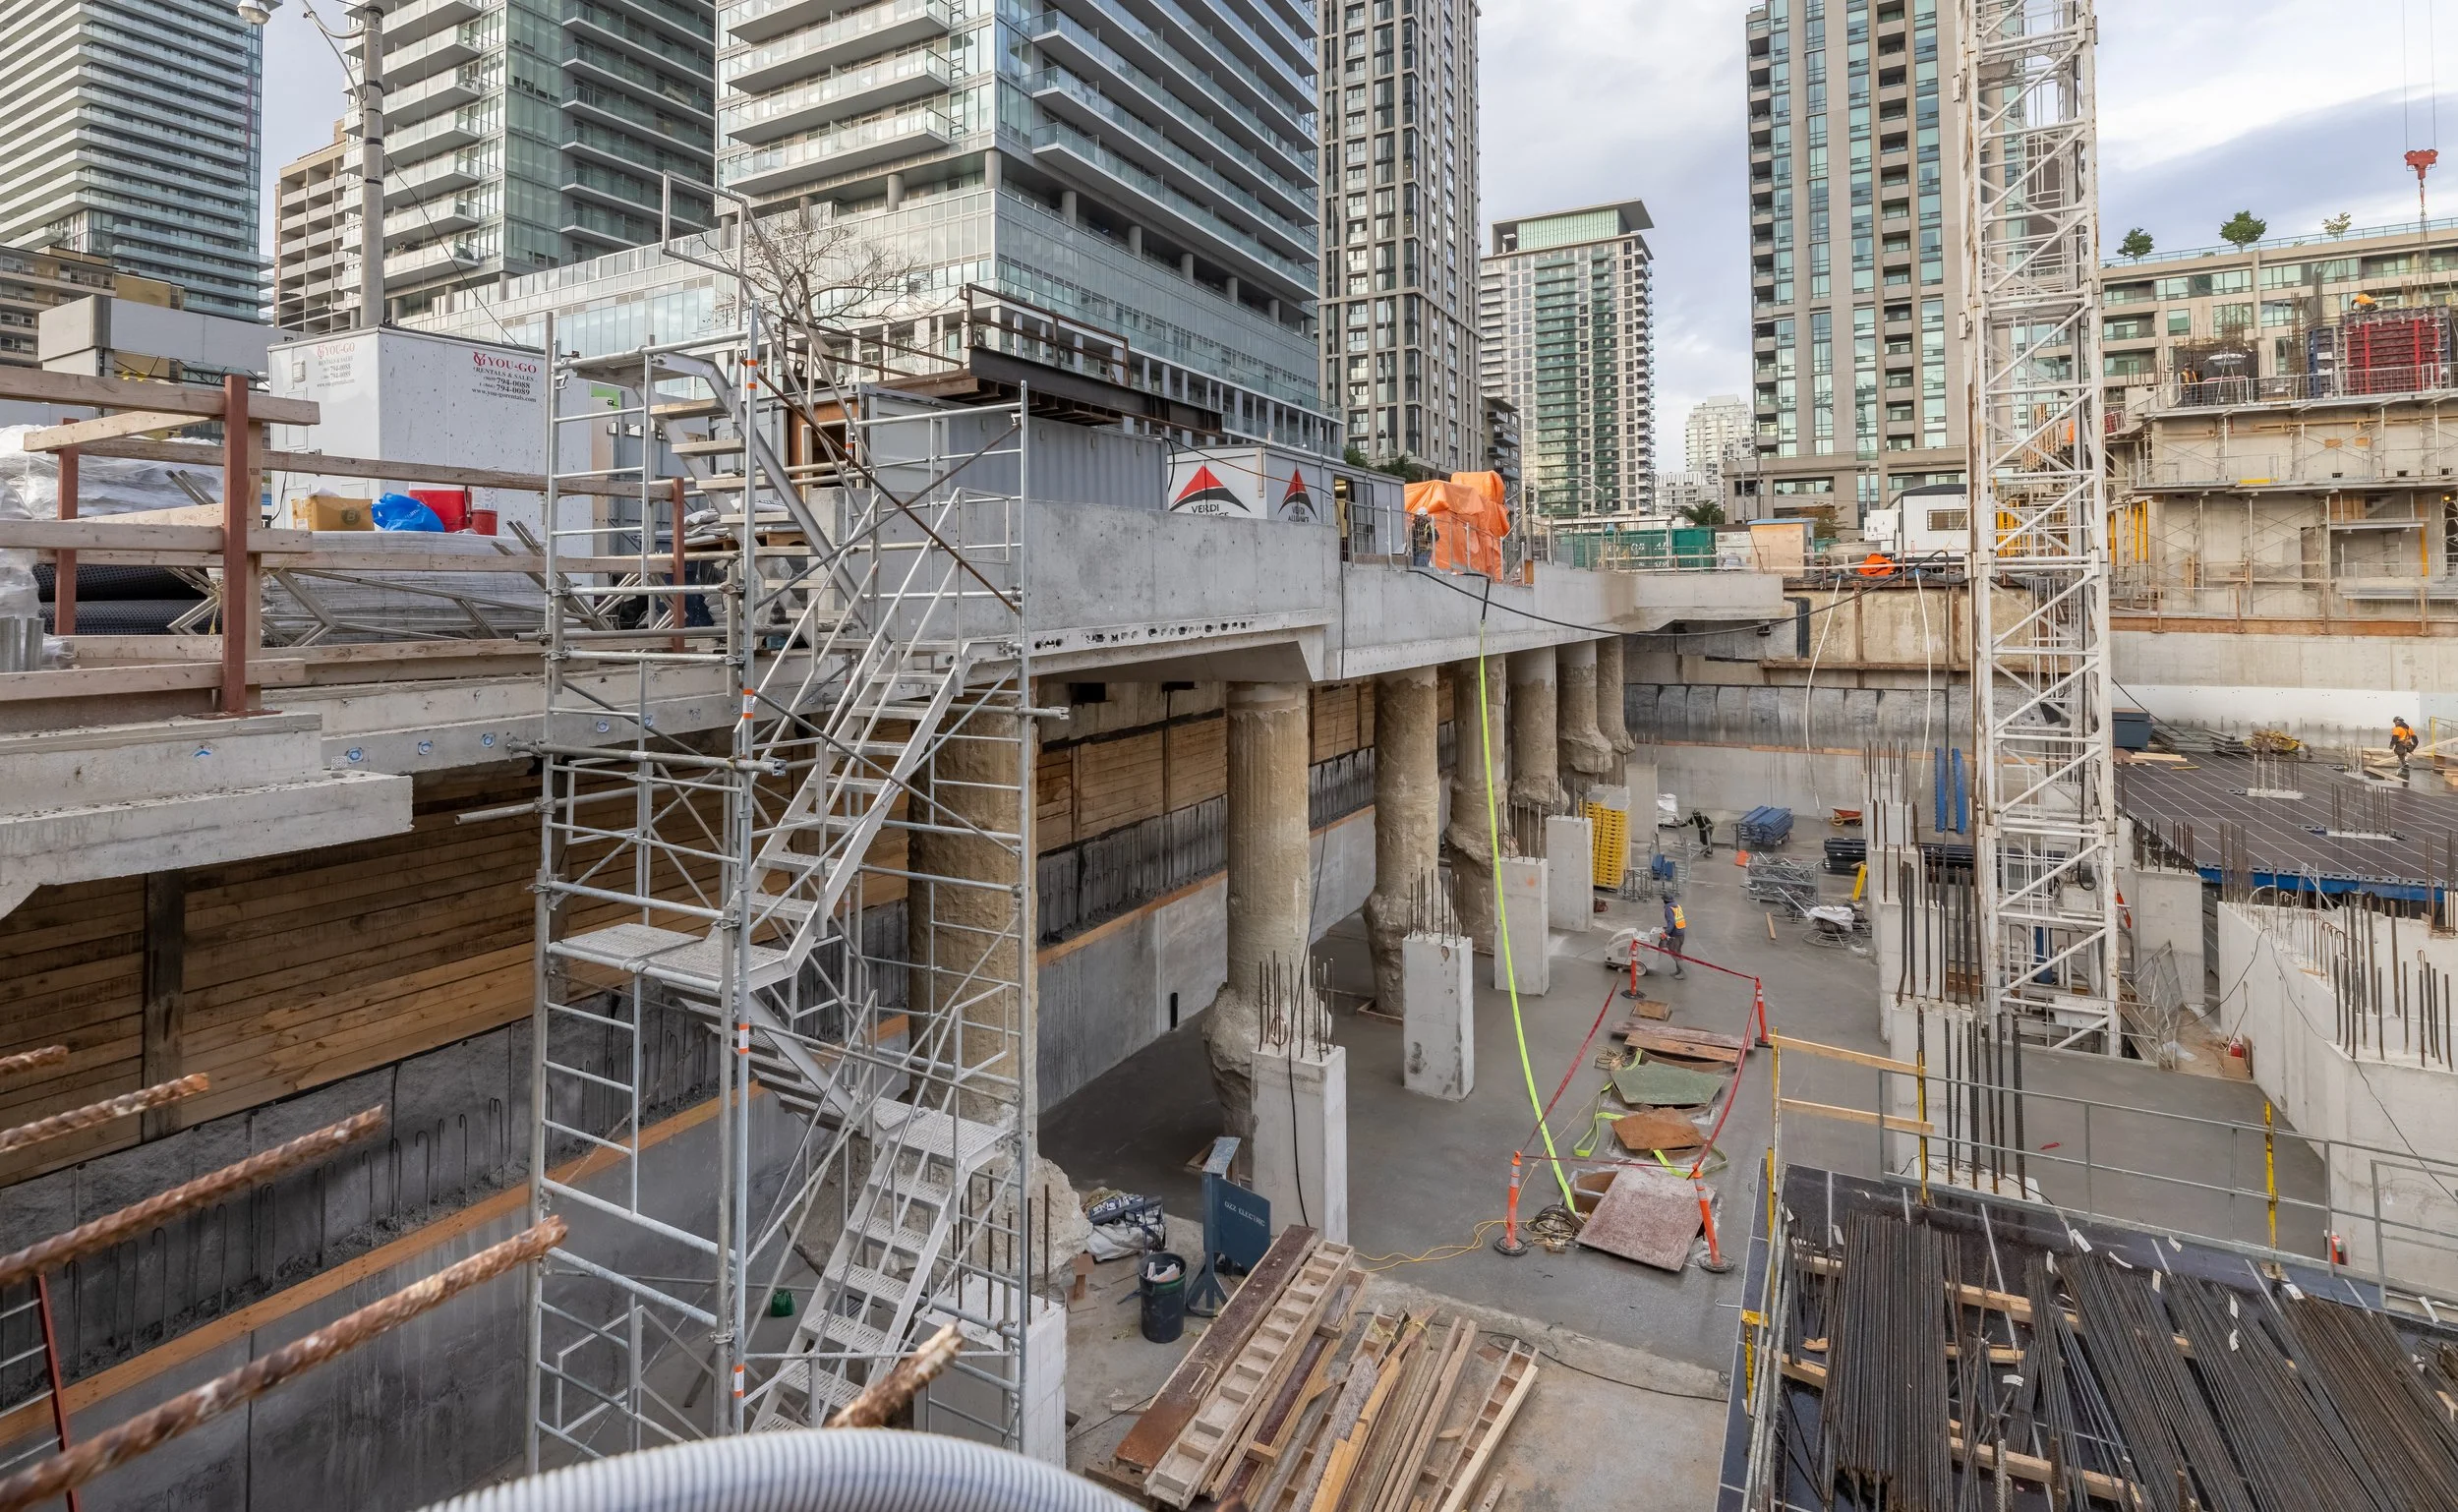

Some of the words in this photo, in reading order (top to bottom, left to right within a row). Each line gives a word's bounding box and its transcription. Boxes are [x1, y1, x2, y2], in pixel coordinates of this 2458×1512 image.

[324, 342, 355, 355] YOU-GO
[488, 356, 537, 374] YOU-GO
[475, 367, 505, 377] RENTALS
[496, 377, 531, 389] 794-0088
[496, 383, 531, 395] 794-0089
[471, 388, 537, 402] www.you-gorentals.com
[1191, 503, 1219, 513] VERDI
[1238, 1207, 1265, 1227] ELECTRIC
